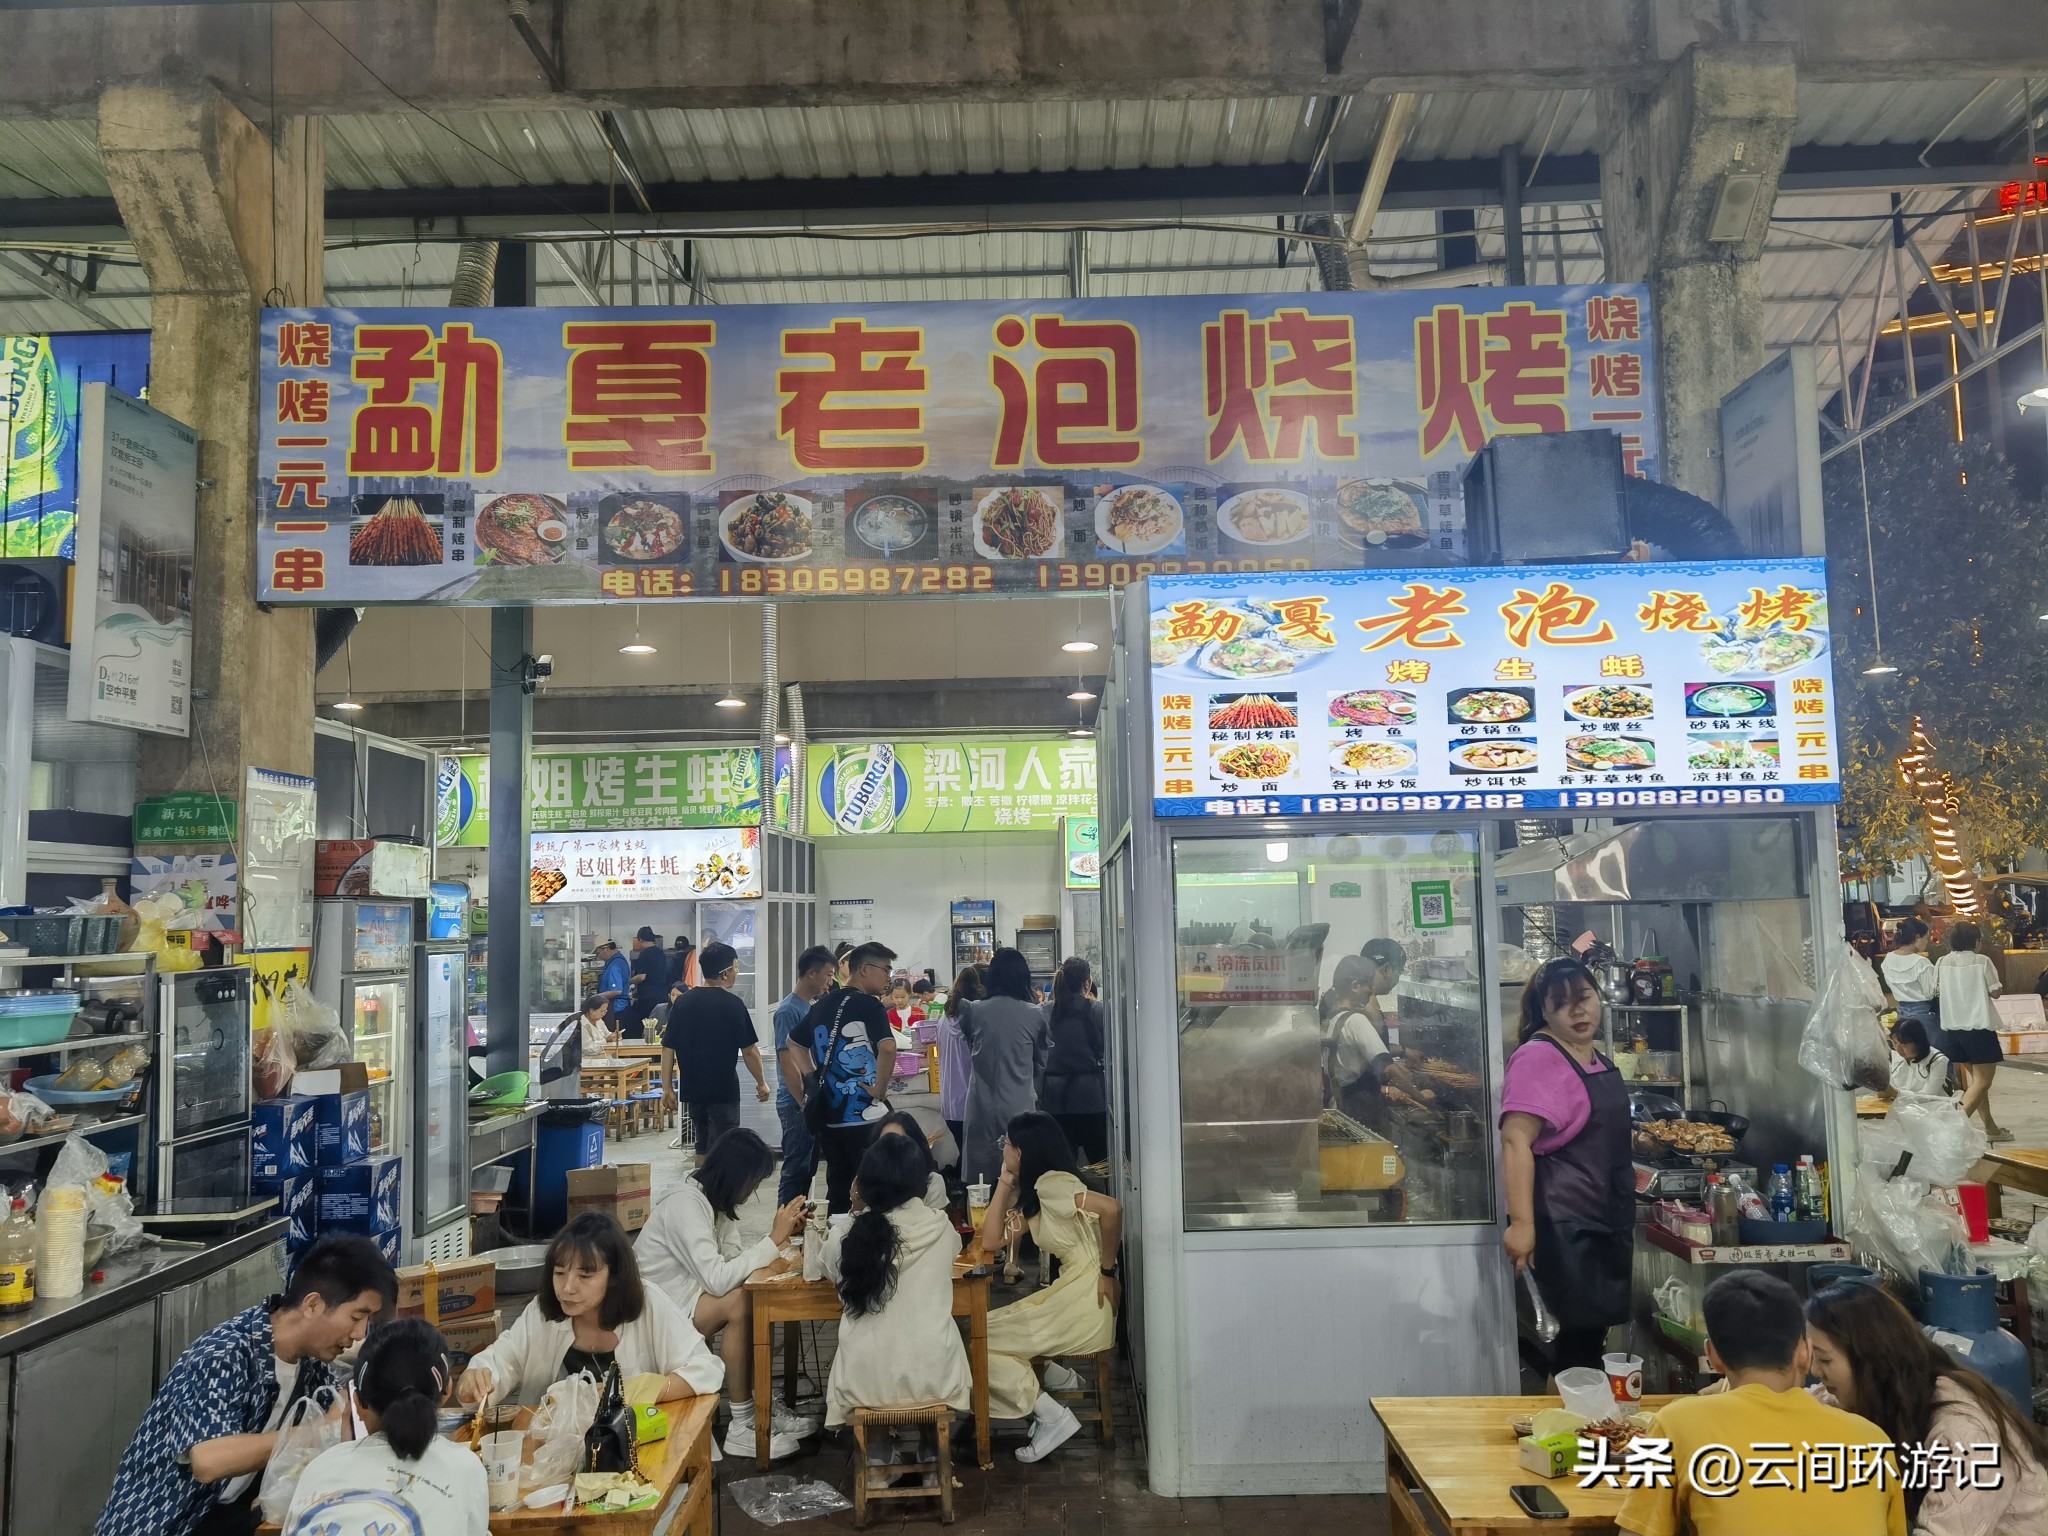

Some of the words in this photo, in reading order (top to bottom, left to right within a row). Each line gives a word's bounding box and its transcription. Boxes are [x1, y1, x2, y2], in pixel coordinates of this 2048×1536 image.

[271, 322, 331, 593] 烧烤一元一串
[452, 499, 465, 562] 秘制烤串
[576, 506, 589, 550] 烤鱼
[1073, 498, 1086, 542] 炒面
[721, 566, 993, 597] 18306987282
[1385, 653, 1646, 684] 烤生蚝
[1345, 727, 1404, 739] 烤鱼
[1460, 724, 1523, 736] 砂锅鱼
[1580, 721, 1643, 733] 炒螺丝
[1690, 718, 1777, 730] 砂锅米线
[1792, 678, 1829, 780] 烧烤一元一串
[1162, 694, 1194, 795] 烧烤一元一串
[1211, 729, 1296, 742] 秘制烤串
[924, 746, 1097, 793] 梁河人家
[1558, 772, 1665, 785] 香茅草烤鱼
[1692, 770, 1779, 782] 凉拌鱼皮
[836, 763, 859, 804] COPENHAGEN
[1221, 781, 1278, 793] 炒面
[1332, 778, 1417, 790] 各种炒饭
[1464, 776, 1528, 788] 炒饵快
[841, 760, 887, 827] TUBORG
[1302, 792, 1524, 813] 18306987282
[1558, 788, 1785, 808] 13908820960
[161, 807, 210, 820] 新玩厂
[879, 796, 892, 819] GREEN
[994, 806, 1098, 826] 烧烤一元一
[141, 825, 230, 838] 美食广场19号摊位
[575, 855, 680, 877] 赵姐烤生蚝
